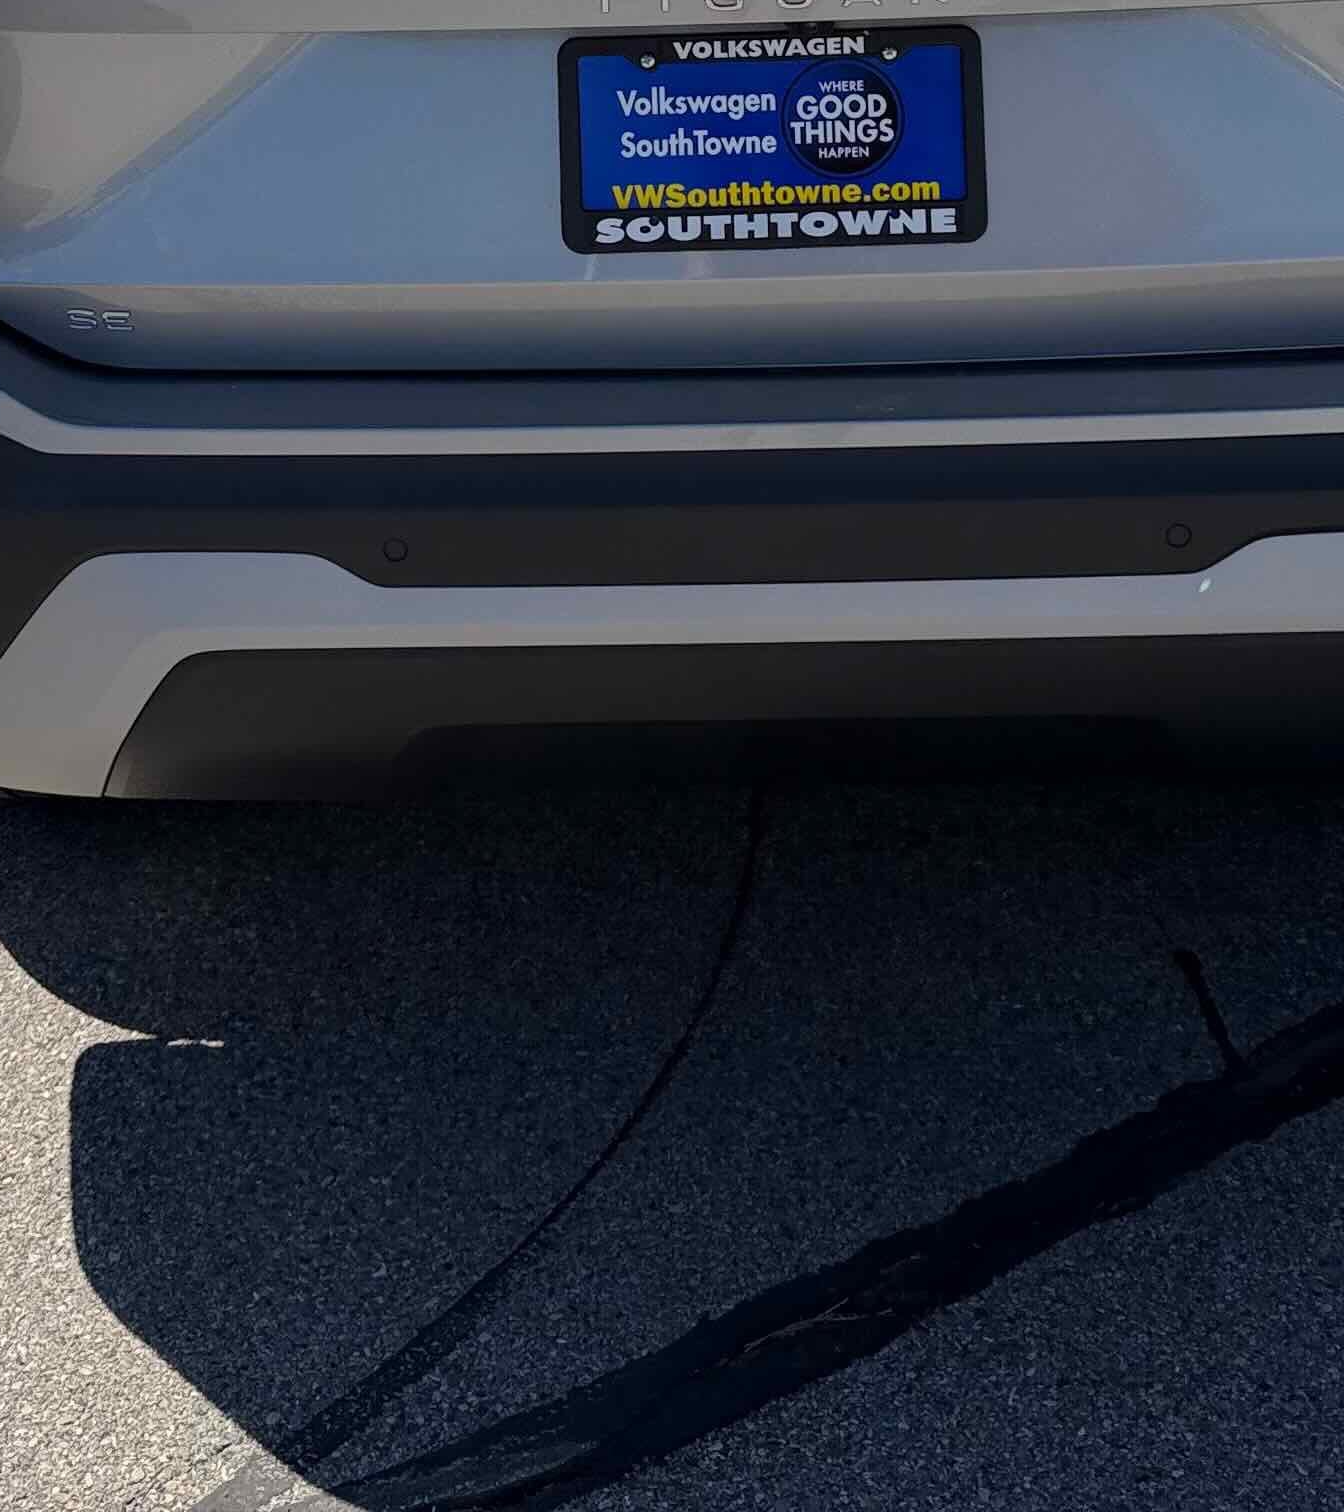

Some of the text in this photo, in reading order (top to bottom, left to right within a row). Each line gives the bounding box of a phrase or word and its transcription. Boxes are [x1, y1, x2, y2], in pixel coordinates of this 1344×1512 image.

[673, 36, 865, 59] VOLKSWAGEN
[818, 80, 864, 92] WHERE
[616, 86, 777, 120] Volkswagen
[796, 93, 887, 120] GOOD
[620, 128, 777, 158] SouthTowne
[790, 118, 895, 145] THINGS
[818, 146, 869, 160] HAPPEN
[612, 180, 941, 209] VWSouthtowne.com
[595, 207, 957, 245] SOUTHTOWNE
[67, 308, 135, 331] SE
